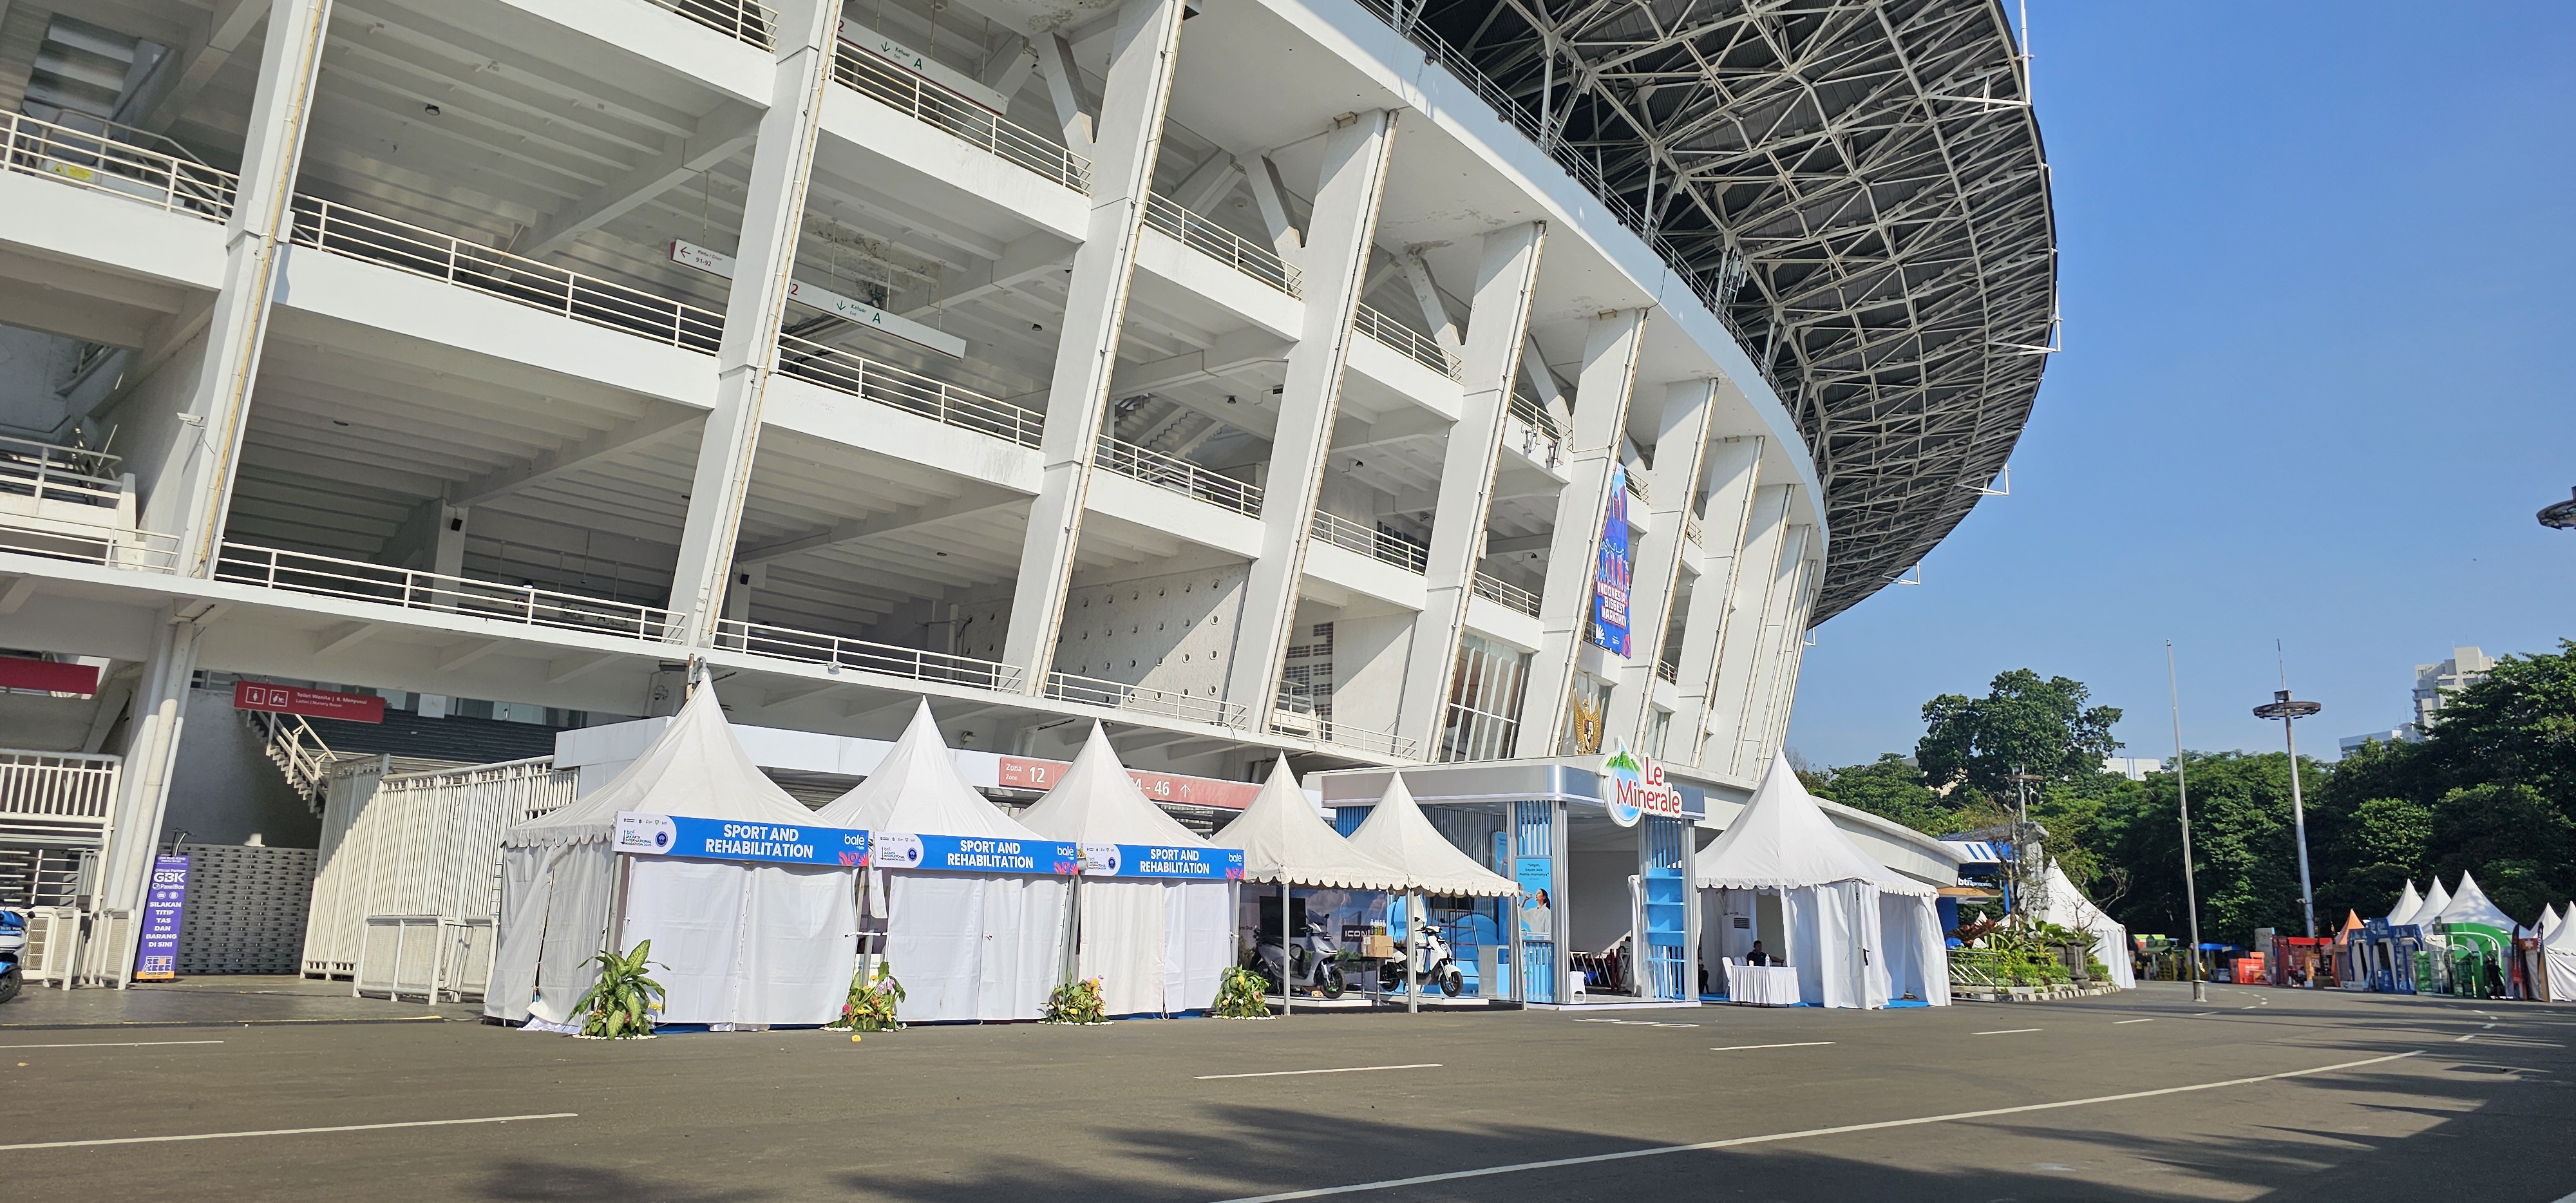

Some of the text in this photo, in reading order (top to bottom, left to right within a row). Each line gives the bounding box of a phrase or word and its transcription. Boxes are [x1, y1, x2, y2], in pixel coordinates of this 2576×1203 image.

[895, 46, 911, 57] Keluar
[914, 58, 922, 70] A
[696, 258, 712, 267] 91-92
[851, 303, 867, 314] Keluar
[872, 312, 881, 324] A
[1604, 596, 1625, 615] BIGGEST
[1602, 607, 1627, 627] MARATHON
[1006, 764, 1022, 772] Zona
[1645, 757, 1662, 786] Le
[1029, 766, 1045, 783] 12
[1154, 781, 1170, 796] 46
[1616, 778, 1680, 814] Minerale
[724, 824, 799, 842] SPORT AND
[705, 838, 813, 858] REHABILITATION
[960, 840, 1021, 855] SPORT AND
[947, 853, 1034, 869] REHABILITATION
[1150, 849, 1199, 861] SPORT AND
[1140, 861, 1209, 875] REHABILITATION
[154, 873, 185, 882] GBK
